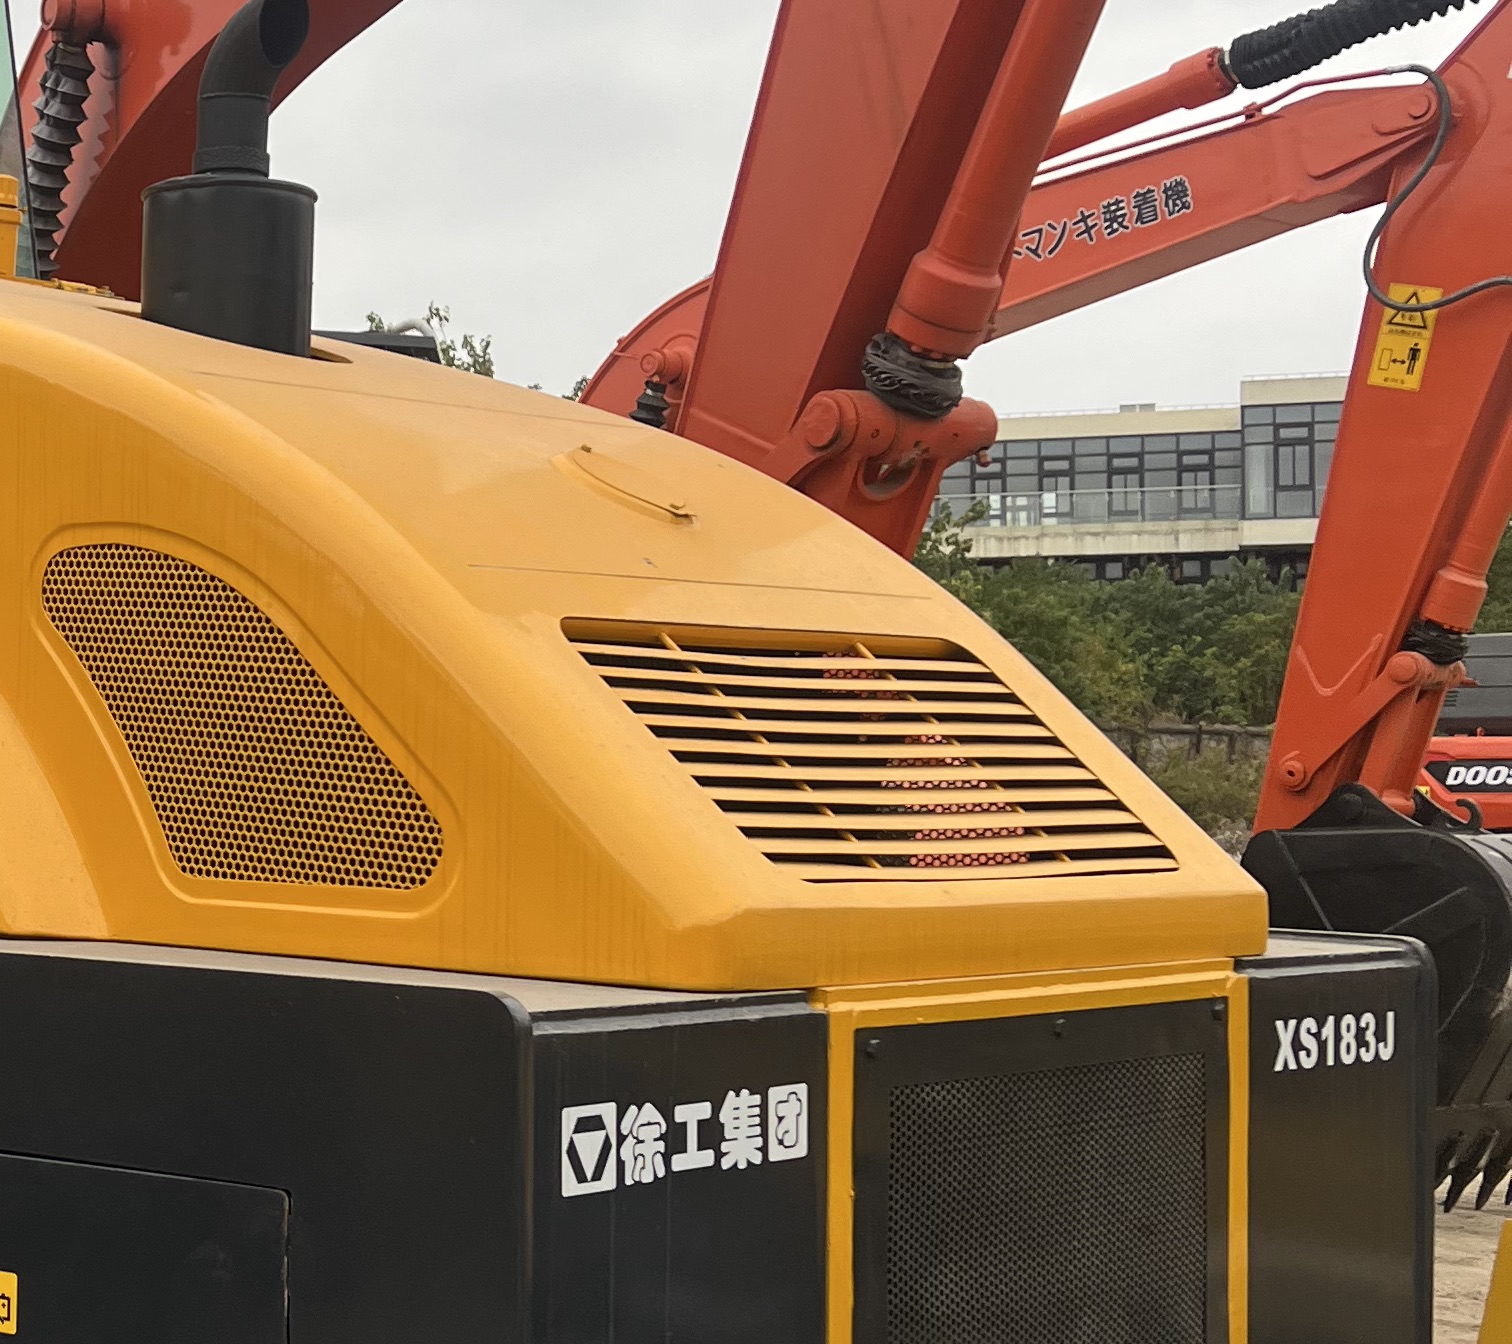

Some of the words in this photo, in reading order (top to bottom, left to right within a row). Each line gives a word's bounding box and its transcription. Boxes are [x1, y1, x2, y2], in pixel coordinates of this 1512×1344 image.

[1013, 176, 1192, 260] マンキ装着機
[1445, 765, 1512, 786] DOO
[1273, 1011, 1395, 1072] XS183J
[620, 1082, 808, 1186] 徐工集团
